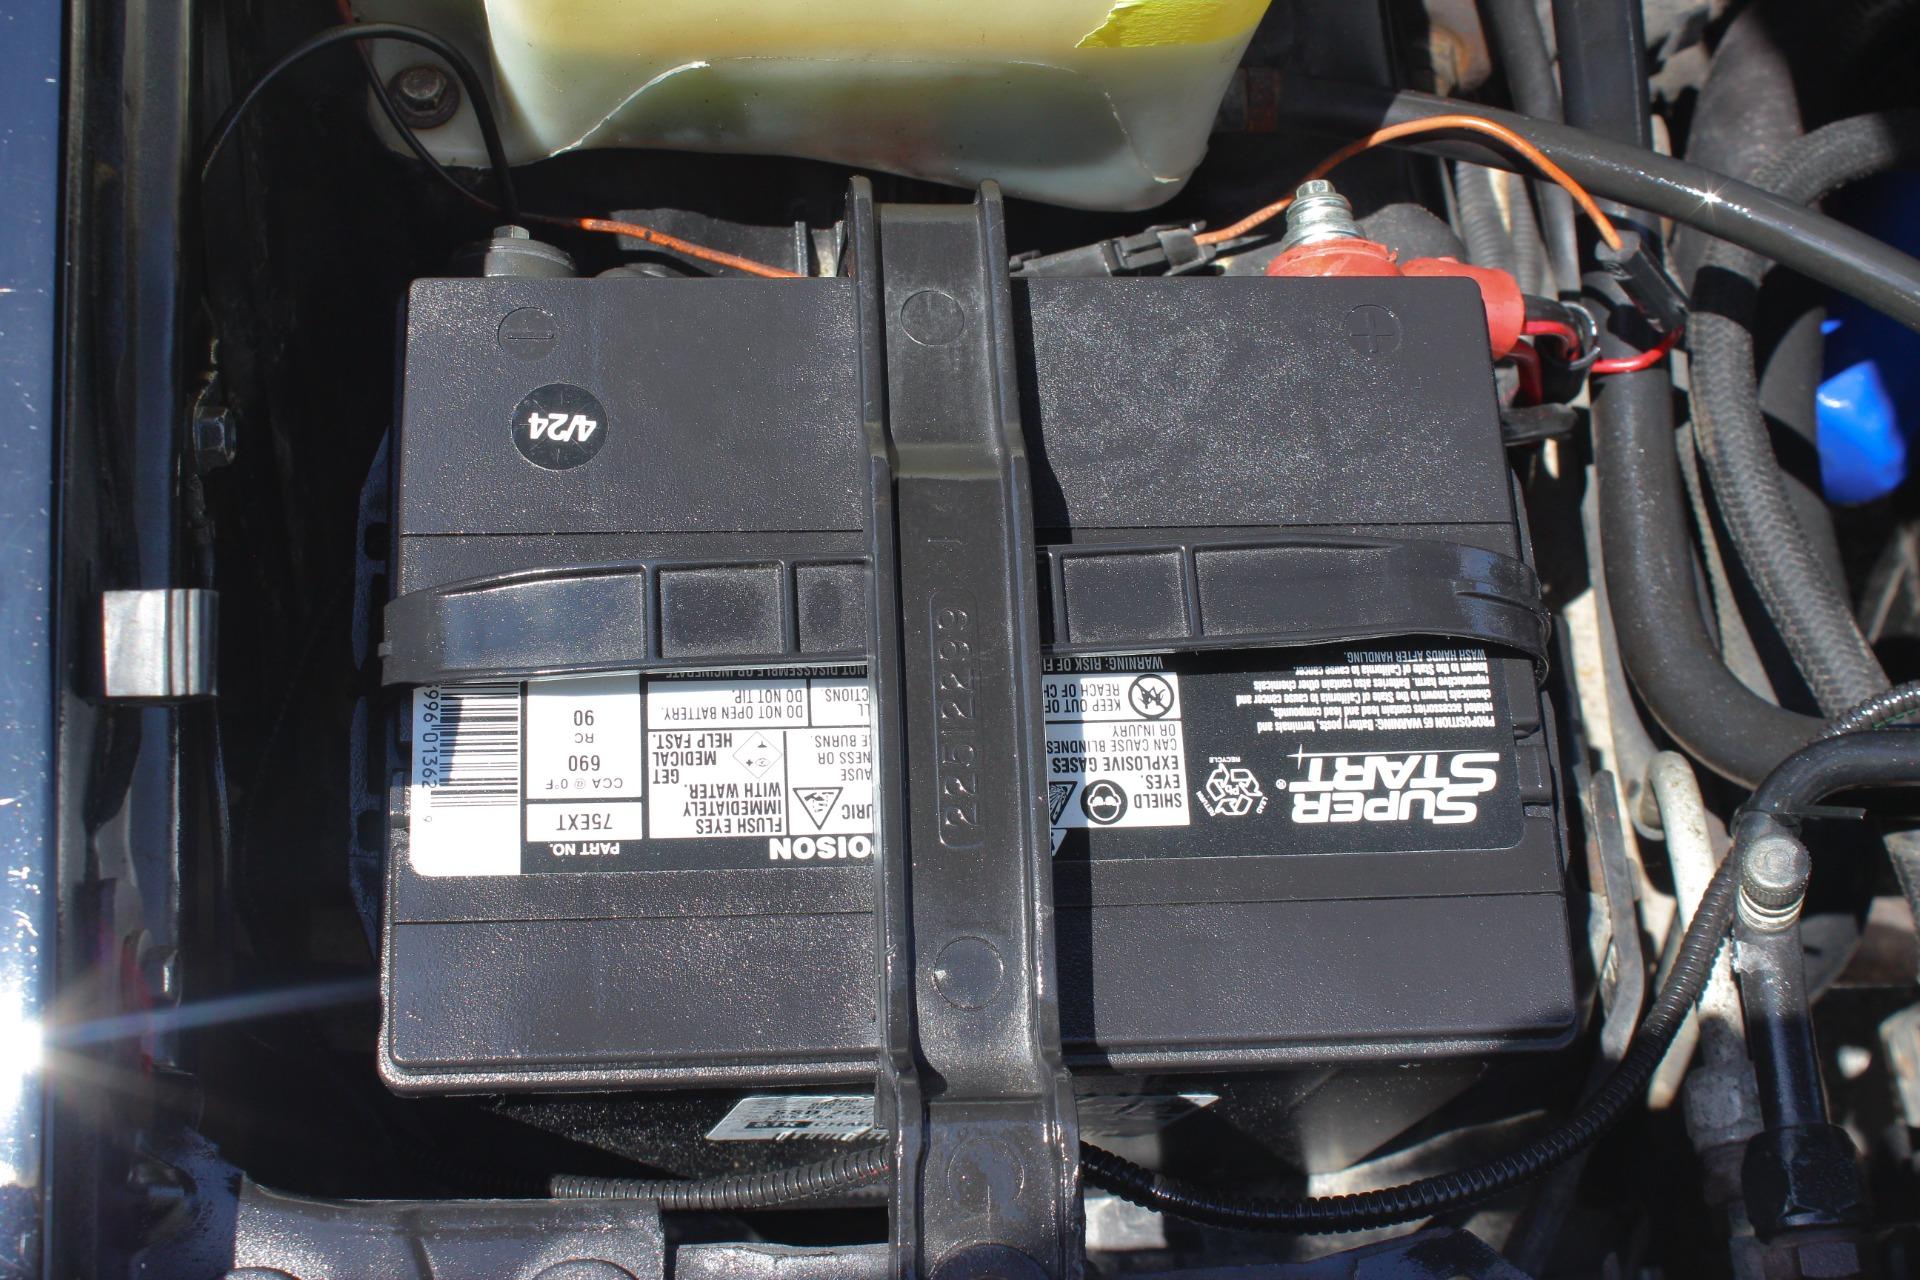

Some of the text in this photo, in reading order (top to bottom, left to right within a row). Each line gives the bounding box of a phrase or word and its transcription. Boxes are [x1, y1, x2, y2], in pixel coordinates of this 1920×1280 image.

[528, 412, 596, 442] 4/24
[1106, 656, 1163, 669] WARNING:
[1344, 649, 1486, 664] WASH HANDS AFTER HANDLING.
[841, 665, 865, 675] NOT
[1057, 659, 1071, 671] OF
[1077, 658, 1101, 670] RISK
[1293, 662, 1488, 677] known to the State of California to cause cancer.
[1081, 684, 1120, 696] REACH
[1254, 674, 1490, 692] reproductive harm. Batteries also contain other chemicals
[732, 690, 802, 703] DO NOT TIP.
[1062, 684, 1076, 697] OF
[1236, 689, 1491, 706] chemicals known to the State of California to cause cancer and
[423, 685, 439, 722] 996
[1045, 699, 1120, 713] KEEP OUT OF
[1381, 705, 1412, 716] contain
[1413, 704, 1462, 715] accessories
[1464, 703, 1493, 714] related
[574, 710, 594, 725] 90
[662, 706, 803, 720] DO NOT OPEN BATTERY.
[1323, 706, 1341, 717] lead
[1343, 706, 1360, 717] and
[1361, 706, 1379, 716] lead
[1257, 721, 1273, 733] and
[1275, 720, 1315, 732] terminals
[1344, 715, 1374, 730] Battery
[1375, 717, 1423, 729] WARNING:
[1423, 717, 1433, 727] 65
[1435, 716, 1495, 728] PROPOSITION
[1160, 724, 1175, 736] OR
[575, 733, 594, 743] RC
[653, 733, 732, 748] HELP FAST.
[811, 736, 856, 747] BURNS.
[1047, 739, 1177, 753] CAN CAUSE BLINDNES
[422, 733, 438, 789] 01362
[568, 755, 600, 771] 690
[653, 751, 716, 766] MEDICAL
[818, 751, 870, 764] NESS OR
[1053, 756, 1178, 773] EXPLOSIVE GASES
[653, 768, 679, 784] GET
[841, 768, 871, 781] AUSE
[1289, 752, 1499, 792] START
[592, 778, 623, 789] CCA
[1141, 774, 1179, 789] EYES.
[684, 782, 781, 798] WITH WATER.
[1225, 785, 1239, 795] Pb
[1134, 793, 1182, 808] SHIELD
[1256, 796, 1268, 814] LEAD
[1292, 790, 1479, 824] SUPER
[683, 800, 781, 816] IMMEDIATELY
[556, 813, 613, 831] 75EXT
[696, 817, 782, 834] FLUSH EYES
[549, 842, 620, 856] PART NO.
[769, 836, 874, 859] OISON
